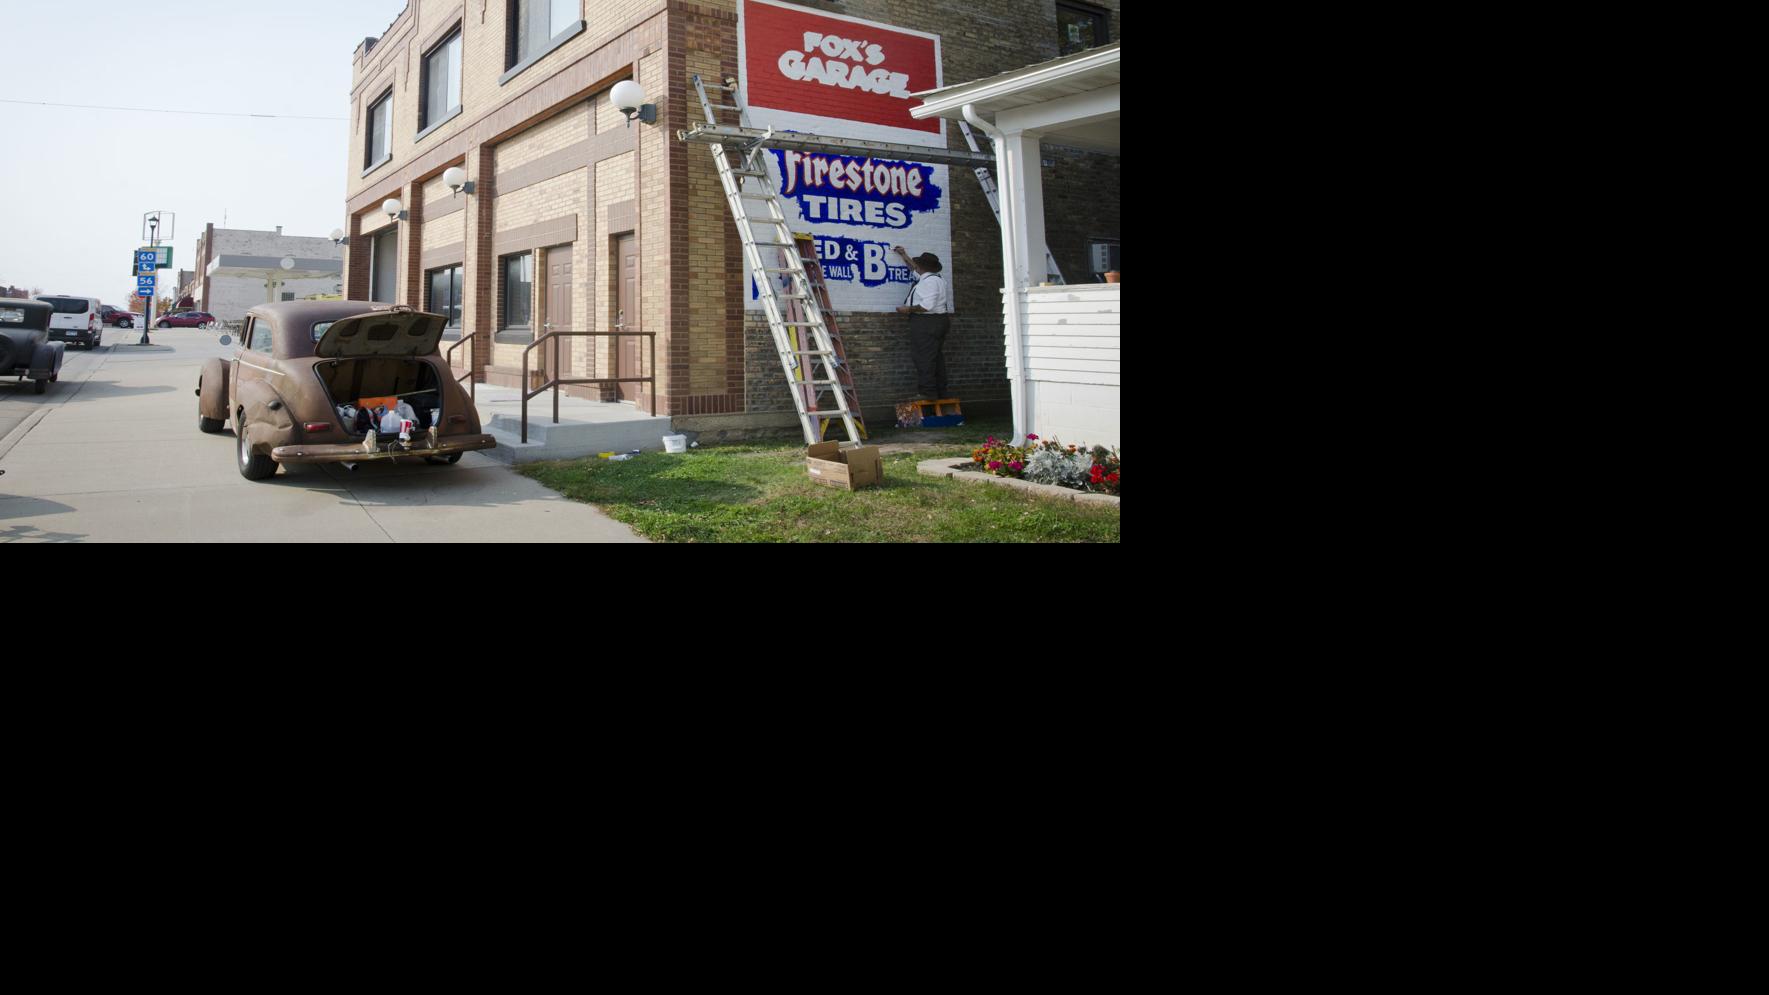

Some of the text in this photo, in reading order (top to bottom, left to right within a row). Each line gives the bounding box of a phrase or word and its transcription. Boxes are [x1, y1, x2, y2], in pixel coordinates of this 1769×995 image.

[803, 31, 885, 65] FOX'S
[778, 50, 911, 99] GARAGE
[784, 150, 923, 197] Firestone
[802, 194, 907, 227] TIRES
[140, 253, 154, 261] 60
[813, 239, 840, 260] ED
[845, 244, 858, 261] &
[140, 277, 153, 285] 56
[829, 265, 852, 278] WALL
[888, 267, 917, 281] TREA
